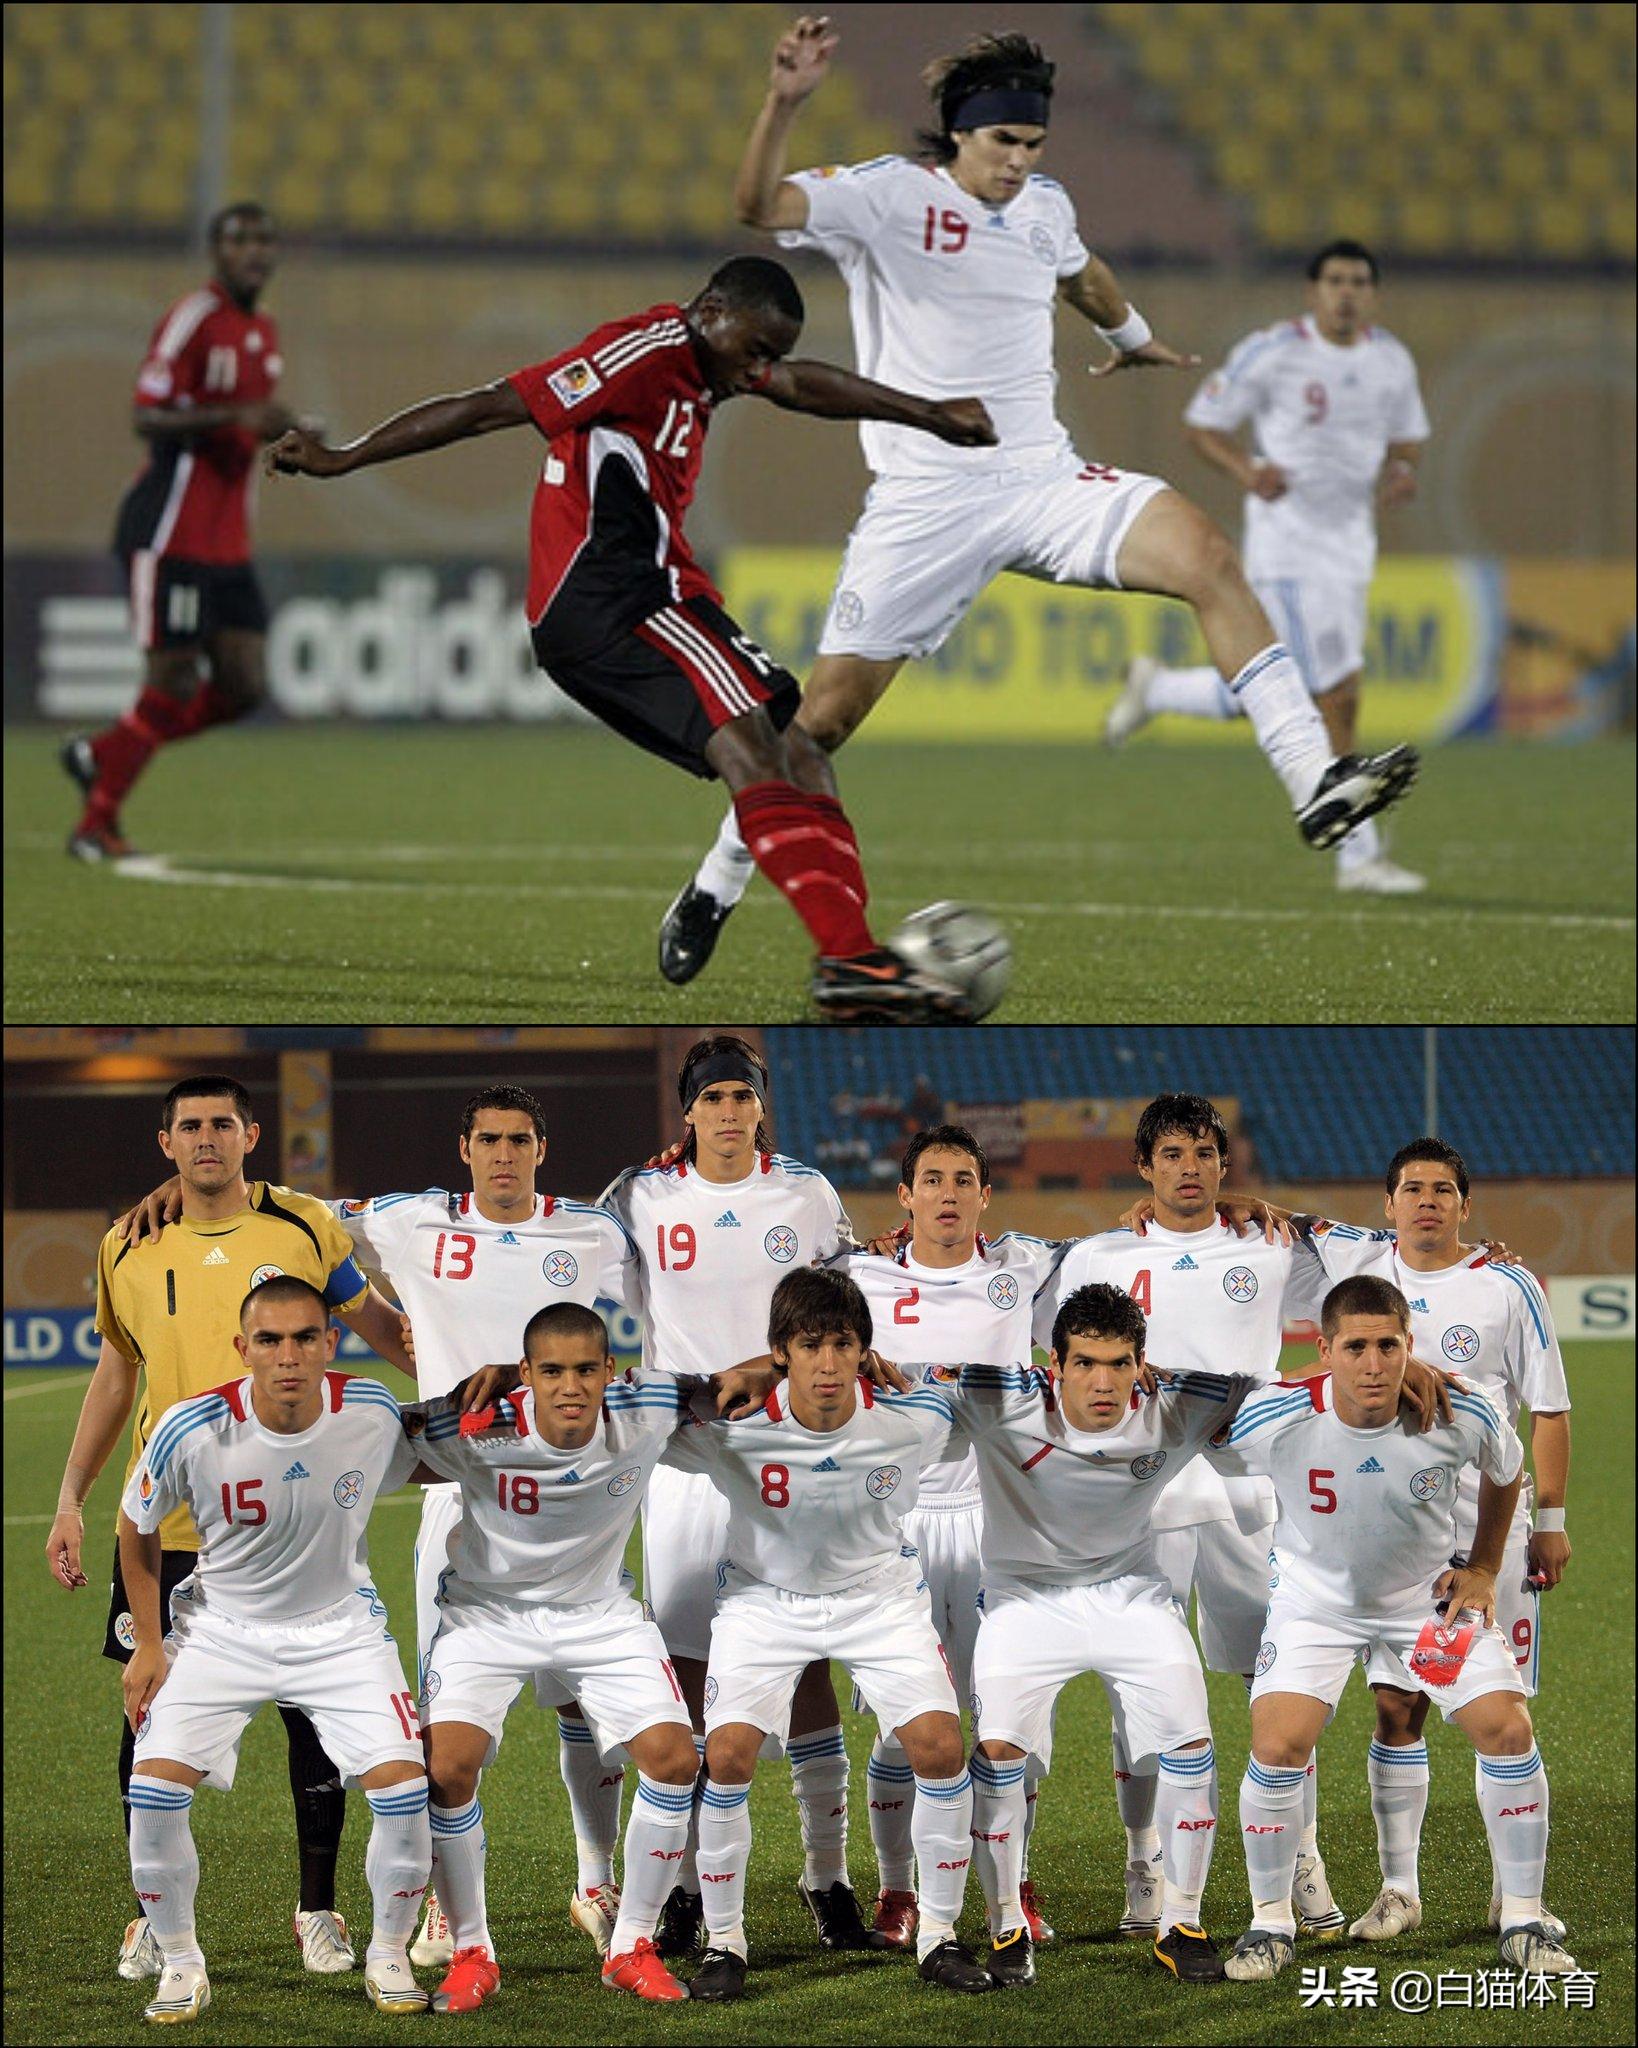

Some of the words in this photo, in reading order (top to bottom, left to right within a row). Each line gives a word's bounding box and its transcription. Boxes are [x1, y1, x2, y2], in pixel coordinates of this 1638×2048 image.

[924, 206, 968, 253] 19
[206, 347, 237, 392] 11
[1303, 382, 1329, 427] 9
[655, 400, 695, 457] 12
[713, 1220, 742, 1228] adidas
[203, 1257, 229, 1265] adidas
[433, 1232, 477, 1281] 13
[657, 1223, 697, 1272] 19
[1171, 1263, 1200, 1271] adidas
[166, 1269, 177, 1316] 1
[894, 1287, 920, 1325] 2
[282, 1472, 311, 1482] adidas
[760, 1463, 790, 1509] 8
[1356, 1466, 1385, 1474] adidas
[221, 1478, 267, 1526] 15
[498, 1473, 540, 1516] 18
[1308, 1468, 1338, 1514] 5
[1511, 1618, 1532, 1665] 9
[870, 1800, 905, 1811] APF
[1499, 1802, 1539, 1817] APF
[969, 1829, 1010, 1843] APF
[1176, 1818, 1216, 1832] APF
[1245, 1824, 1286, 1834] APF
[701, 1872, 736, 1883] APF
[936, 1858, 970, 1870] APF
